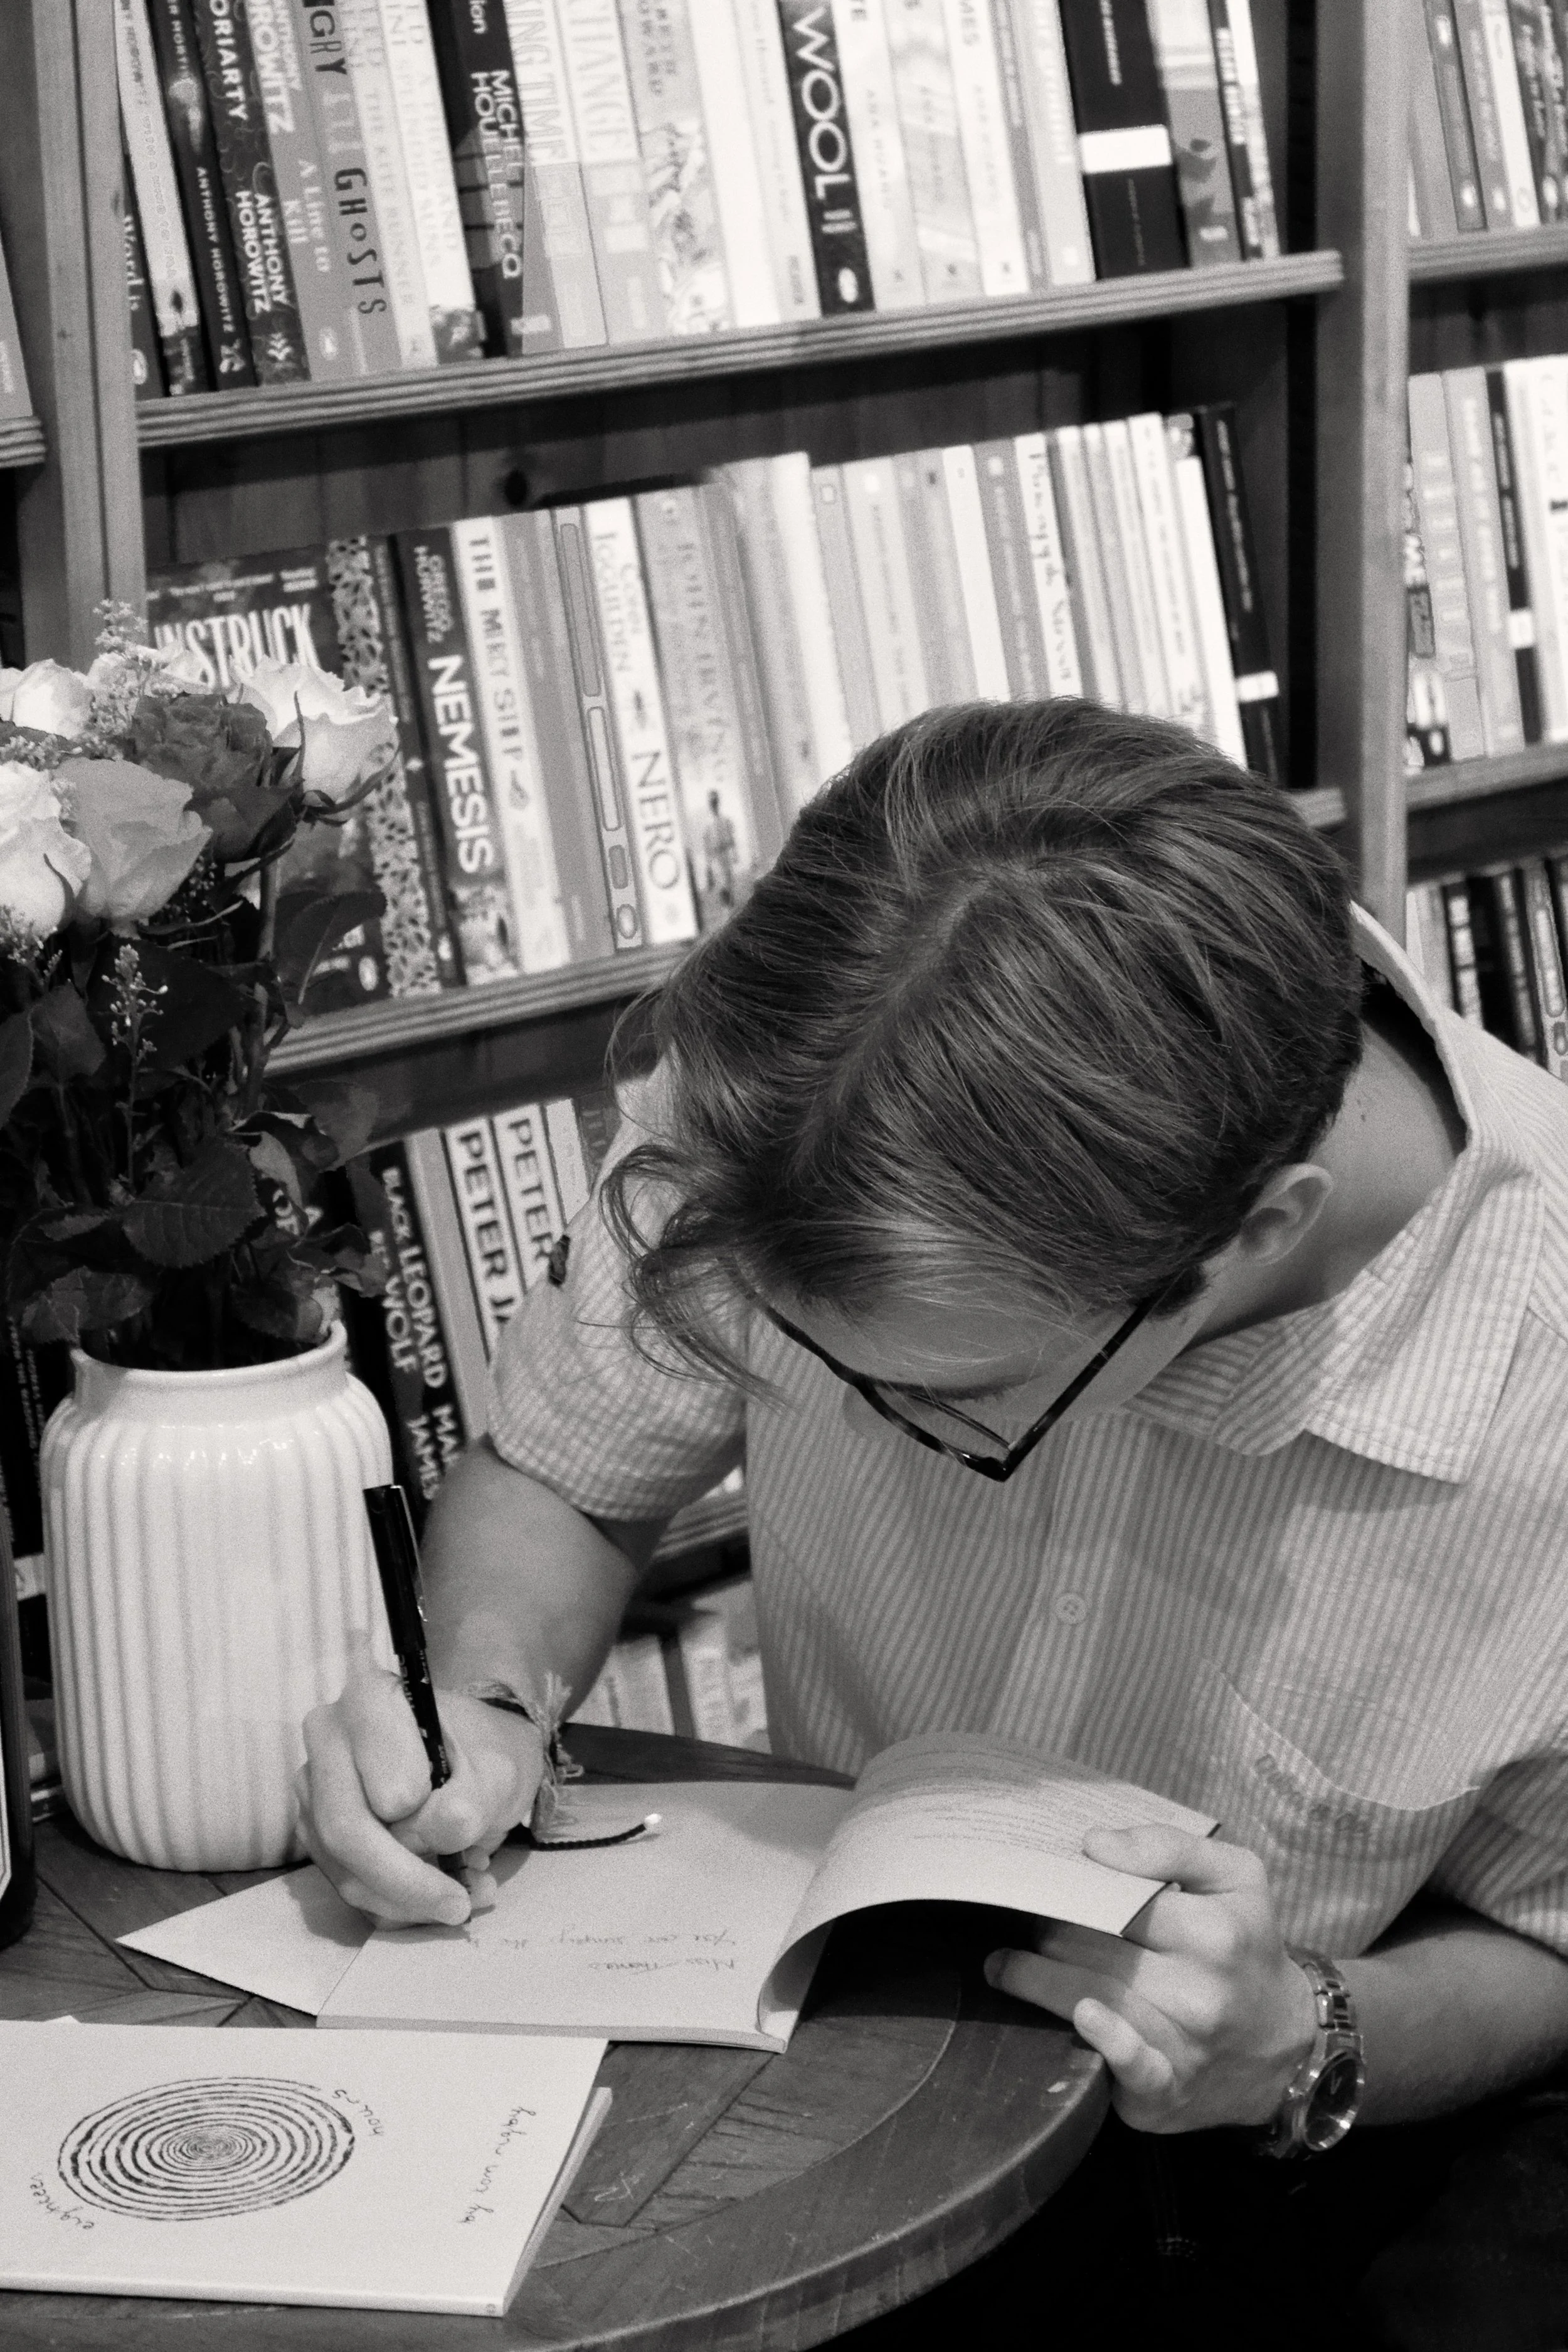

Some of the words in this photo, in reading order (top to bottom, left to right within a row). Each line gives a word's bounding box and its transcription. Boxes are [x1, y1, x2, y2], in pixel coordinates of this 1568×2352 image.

[297, 157, 315, 179] A
[470, 70, 522, 280] HOUELLEBECQ
[489, 68, 524, 173] MICHEL
[195, 166, 218, 243] ANTHONY
[210, 247, 234, 334] HOROWITZ
[235, 189, 272, 315] HOROWITZ
[254, 191, 287, 307] ANTHONY
[281, 198, 309, 245] Kill
[302, 186, 327, 241] Line
[313, 244, 332, 274] to
[331, 165, 389, 319] GHOSTS
[411, 543, 444, 645] HURWITZ
[426, 653, 497, 876] NEMESIS
[629, 750, 682, 893] NERO
[380, 1165, 415, 1242] BLACK
[456, 1130, 510, 1281] PETER
[505, 1116, 556, 1263] PETER
[375, 1273, 421, 1376] WOLF
[396, 1244, 449, 1391] LEOPARD
[406, 1413, 446, 1502] JAMES
